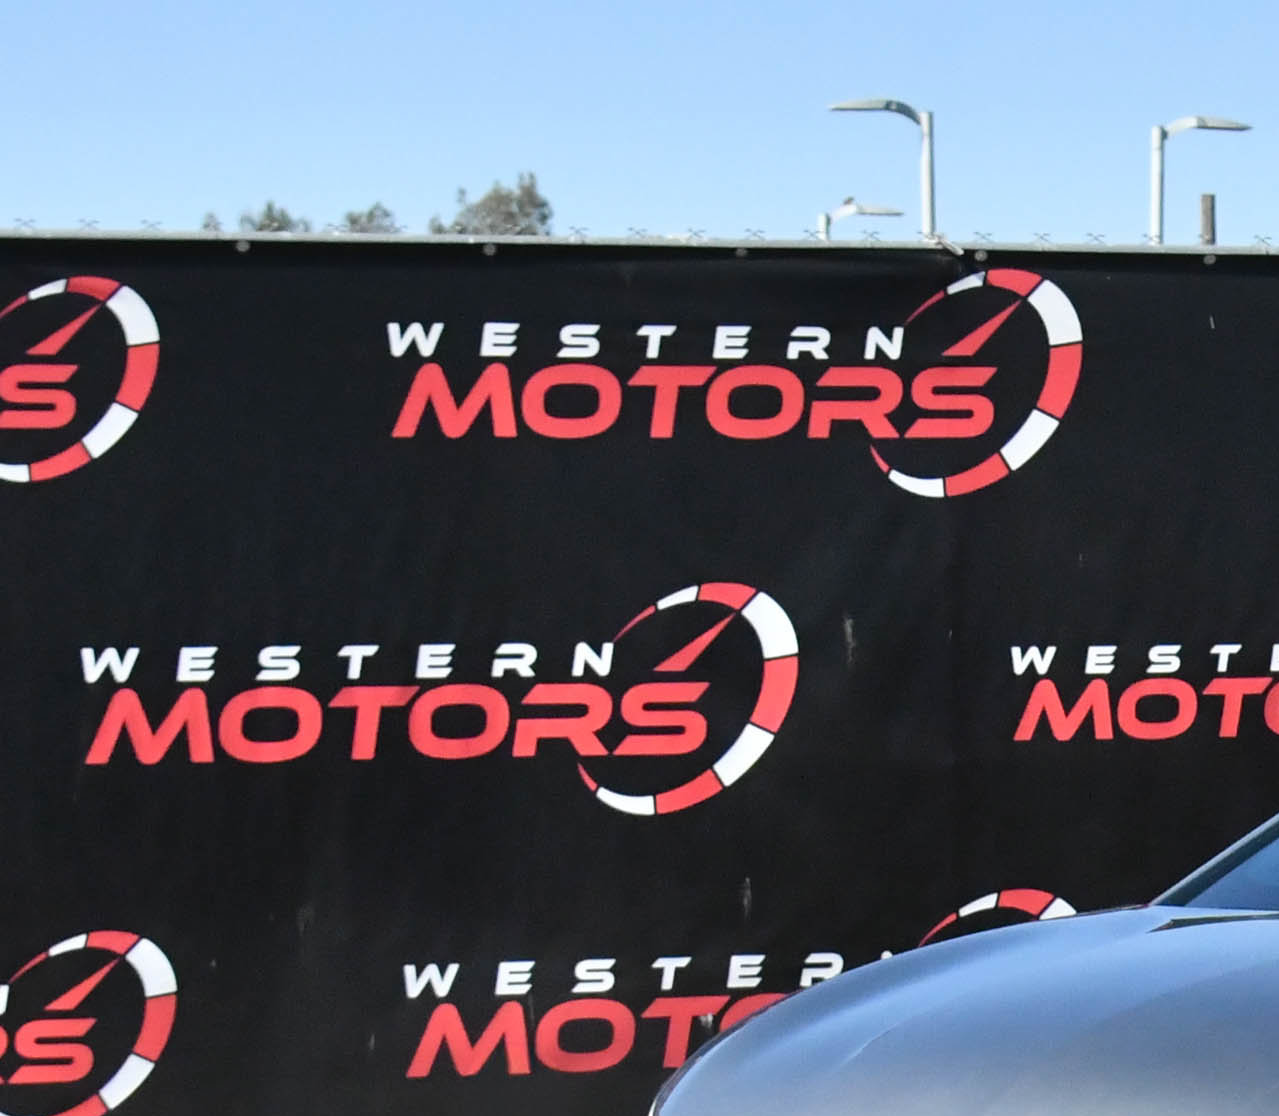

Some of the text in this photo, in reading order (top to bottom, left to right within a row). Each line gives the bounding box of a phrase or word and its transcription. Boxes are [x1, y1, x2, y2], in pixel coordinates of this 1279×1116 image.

[388, 323, 903, 359] WESTERN
[392, 363, 996, 439] MOTORS
[81, 642, 613, 683] WESTERN
[86, 682, 709, 764] MOTORS
[404, 951, 893, 998] WESTER
